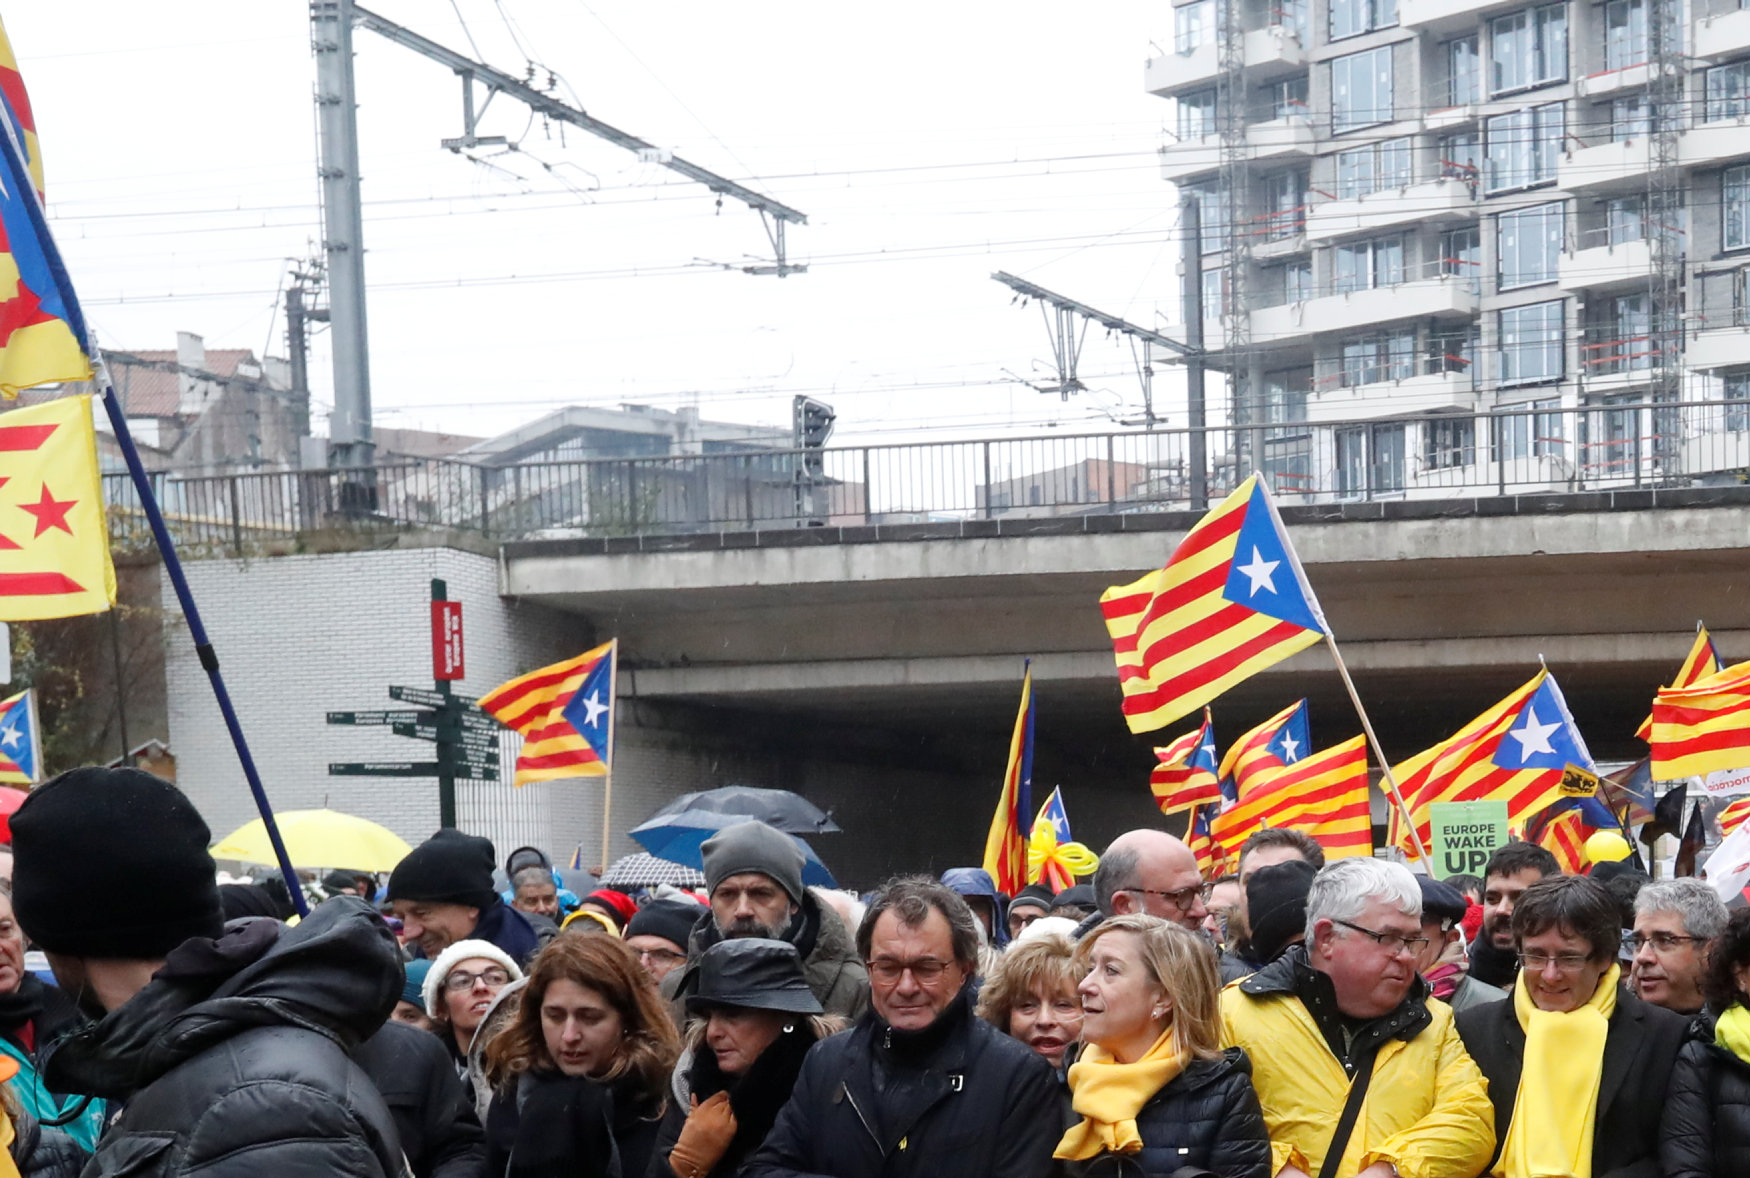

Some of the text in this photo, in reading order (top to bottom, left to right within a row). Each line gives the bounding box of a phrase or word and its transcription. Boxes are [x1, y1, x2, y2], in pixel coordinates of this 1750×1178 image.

[1443, 824, 1496, 835] EUROPE
[1444, 835, 1496, 849] WAKE
[1445, 850, 1493, 874] UP
